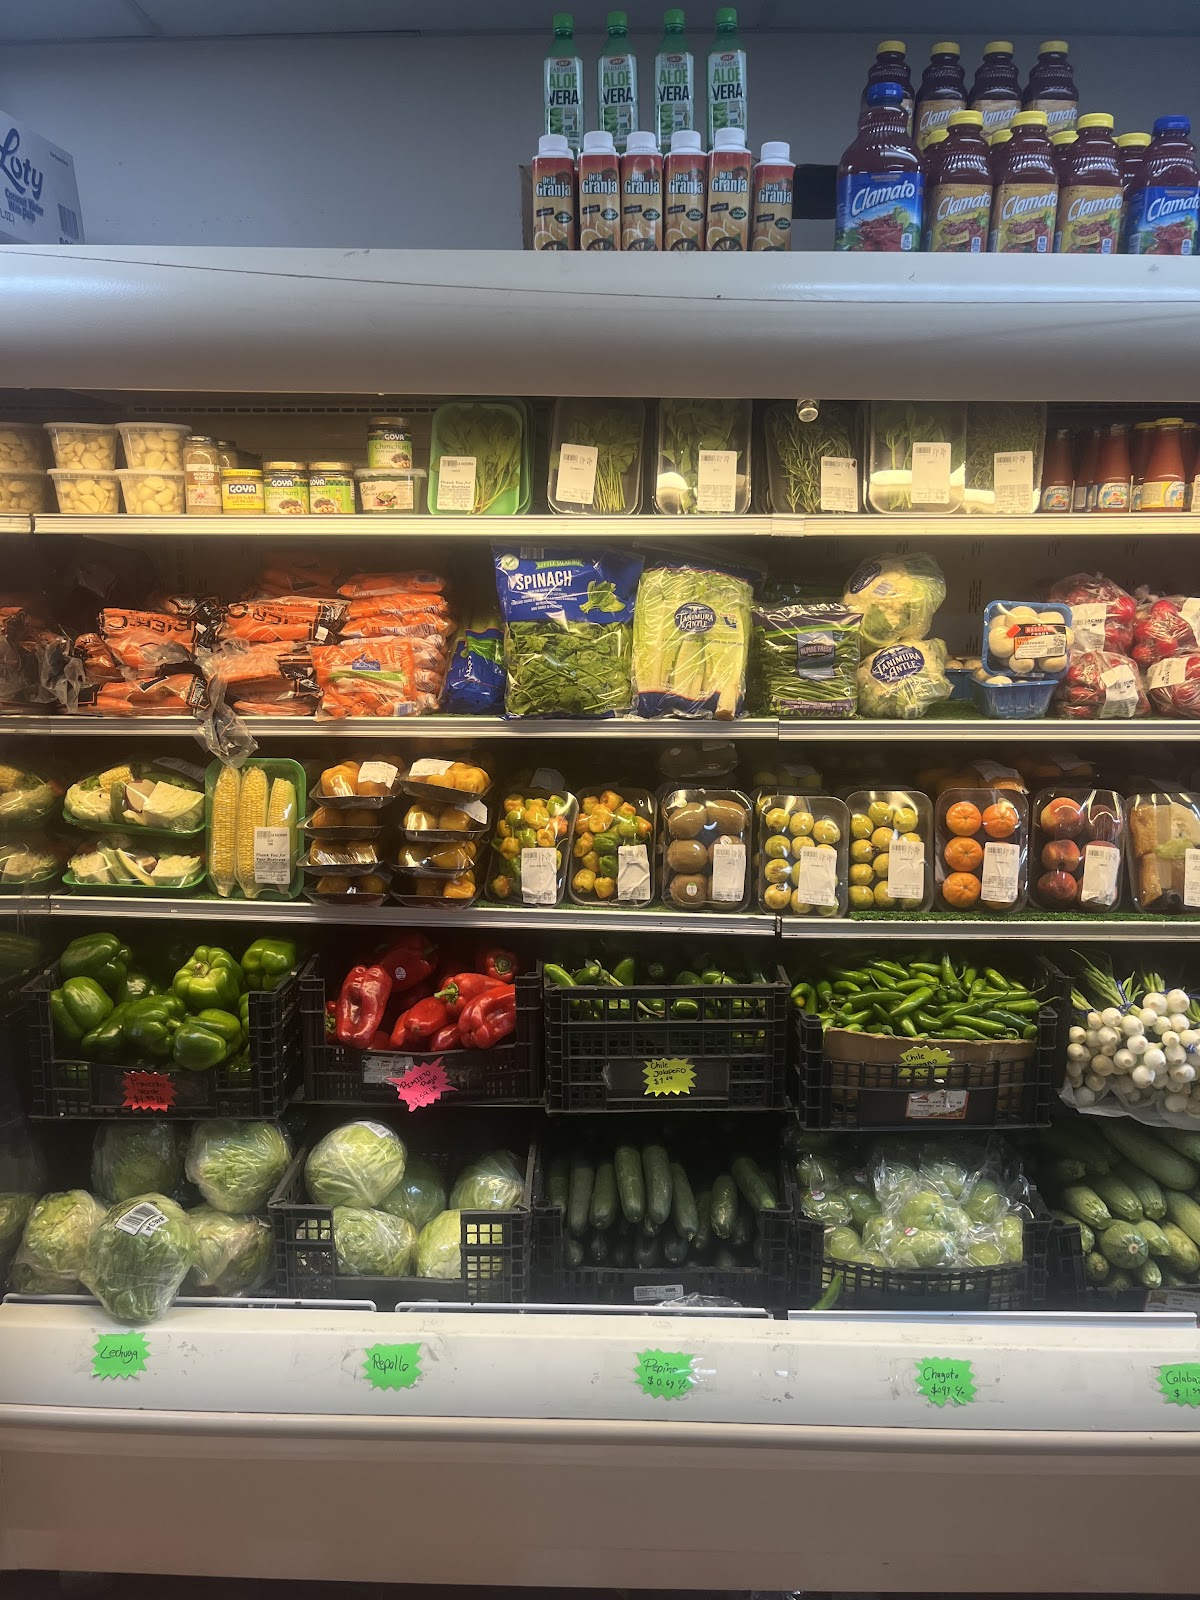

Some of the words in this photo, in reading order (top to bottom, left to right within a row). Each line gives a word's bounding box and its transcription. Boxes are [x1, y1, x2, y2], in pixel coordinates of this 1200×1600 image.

[549, 73, 578, 89] ALOE
[603, 71, 632, 88] ALOE
[659, 69, 688, 85] ALOE
[713, 67, 741, 84] ALOE
[549, 90, 580, 106] VERA
[603, 87, 634, 104] VERA
[658, 85, 690, 102] VERA
[711, 83, 743, 102] VERA
[536, 182, 572, 198] Granja
[582, 179, 618, 194] Granja
[624, 180, 660, 195] Granja
[668, 180, 703, 196] Granja
[712, 178, 748, 194] Granja
[758, 190, 792, 205] Granja
[851, 180, 915, 216] Clamato
[1002, 191, 1058, 220] Clamato
[936, 192, 991, 220] Clamato
[1068, 194, 1122, 222] Clamato
[230, 484, 256, 493] GOYA
[516, 570, 572, 590] SPINACH
[676, 612, 714, 626] TANIMURA
[684, 620, 708, 630] ANTLE
[872, 652, 921, 676] TANIMURA
[887, 660, 917, 682] ANTLE
[906, 1054, 925, 1062] Chile
[100, 1346, 137, 1364] Lechuga
[372, 1353, 409, 1374] Repollo
[643, 1359, 678, 1374] Pepino
